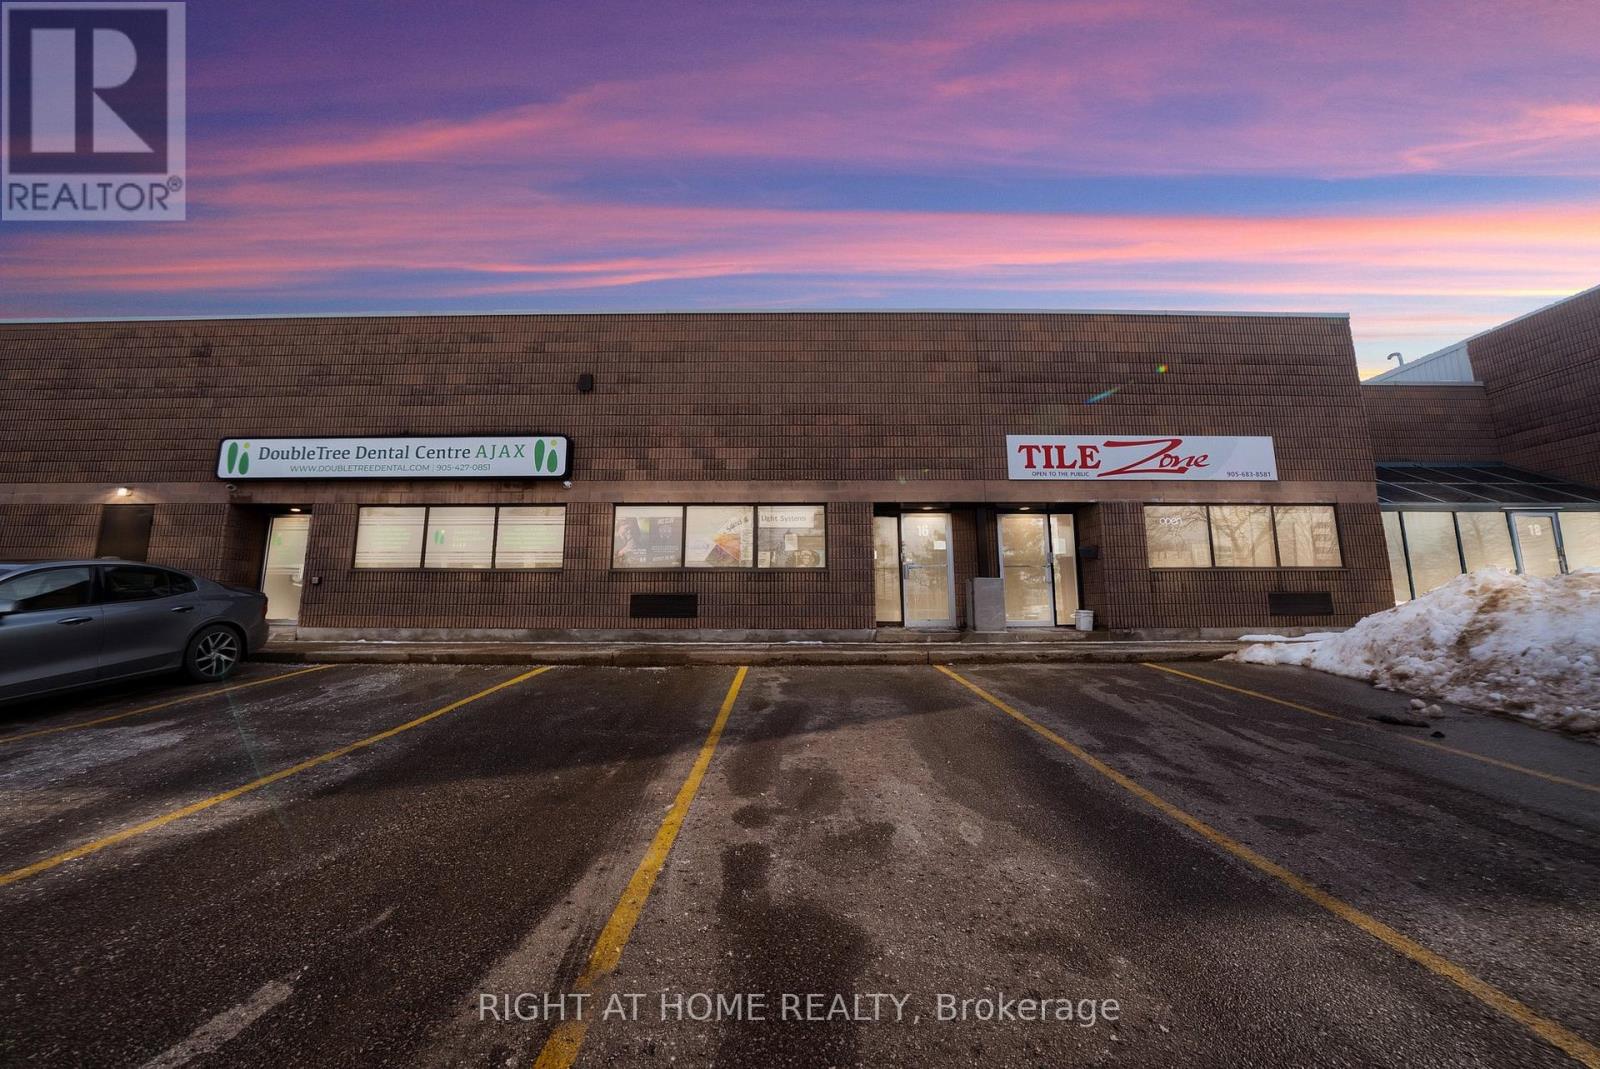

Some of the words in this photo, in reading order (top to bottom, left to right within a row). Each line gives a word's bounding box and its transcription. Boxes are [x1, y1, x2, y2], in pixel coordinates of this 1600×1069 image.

[259, 446, 351, 460] DoubleTree
[356, 445, 409, 460] Dental
[416, 445, 470, 459] Centre
[475, 444, 526, 460] AJAX
[1018, 445, 1101, 469] TILE
[1097, 438, 1210, 478] Zone
[290, 464, 430, 472] WWW.DOUBLETREEDENTAL.COM
[1160, 517, 1183, 527] open
[917, 525, 929, 537] 16
[1529, 524, 1542, 536] 18
